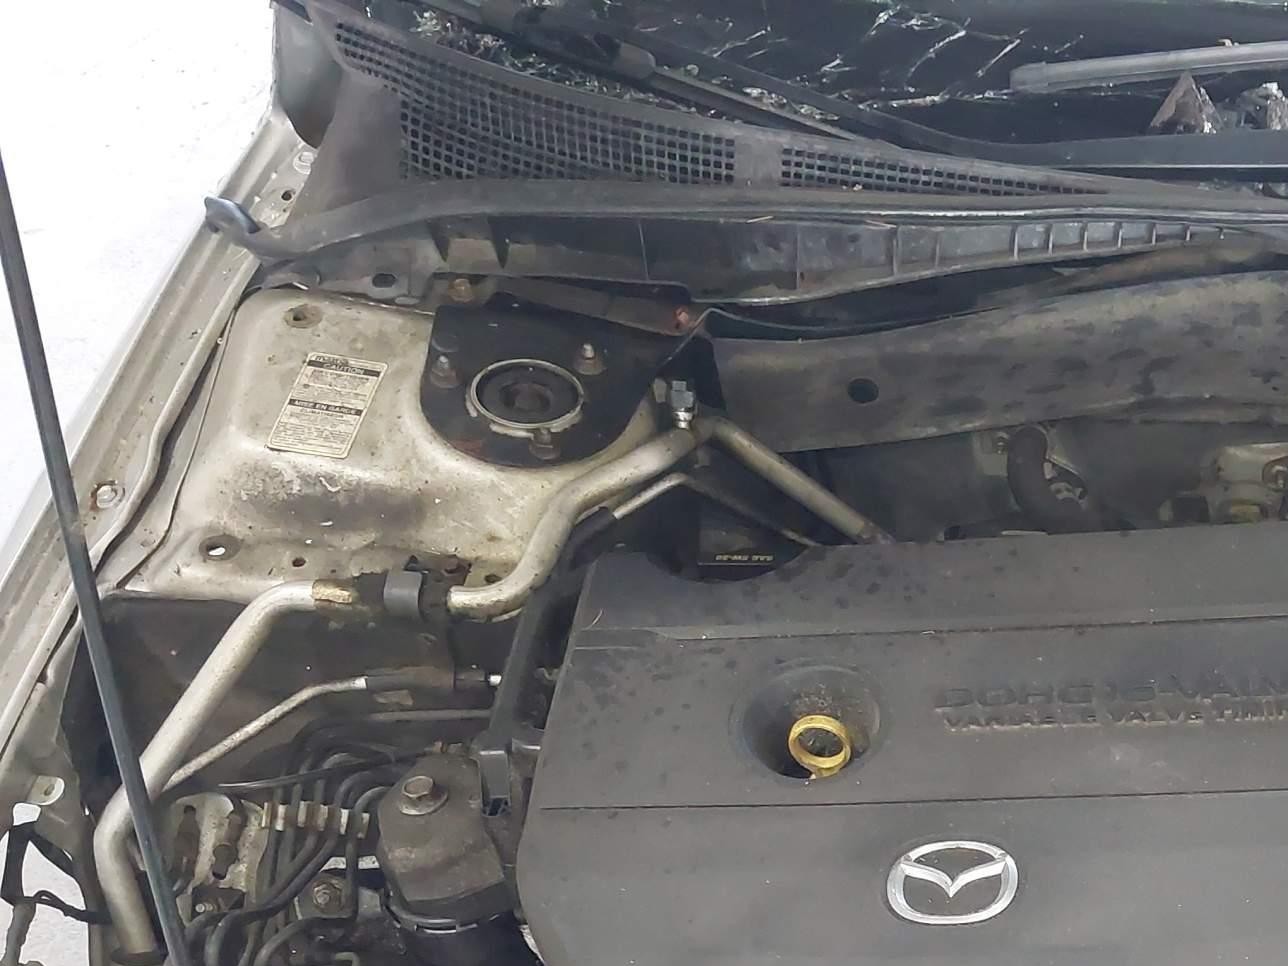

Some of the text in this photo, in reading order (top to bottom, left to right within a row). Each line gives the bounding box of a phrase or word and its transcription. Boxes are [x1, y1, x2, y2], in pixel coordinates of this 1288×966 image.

[323, 363, 365, 374] CAUTION
[935, 683, 1097, 712] DOHC
[1106, 707, 1205, 727] VALVE
